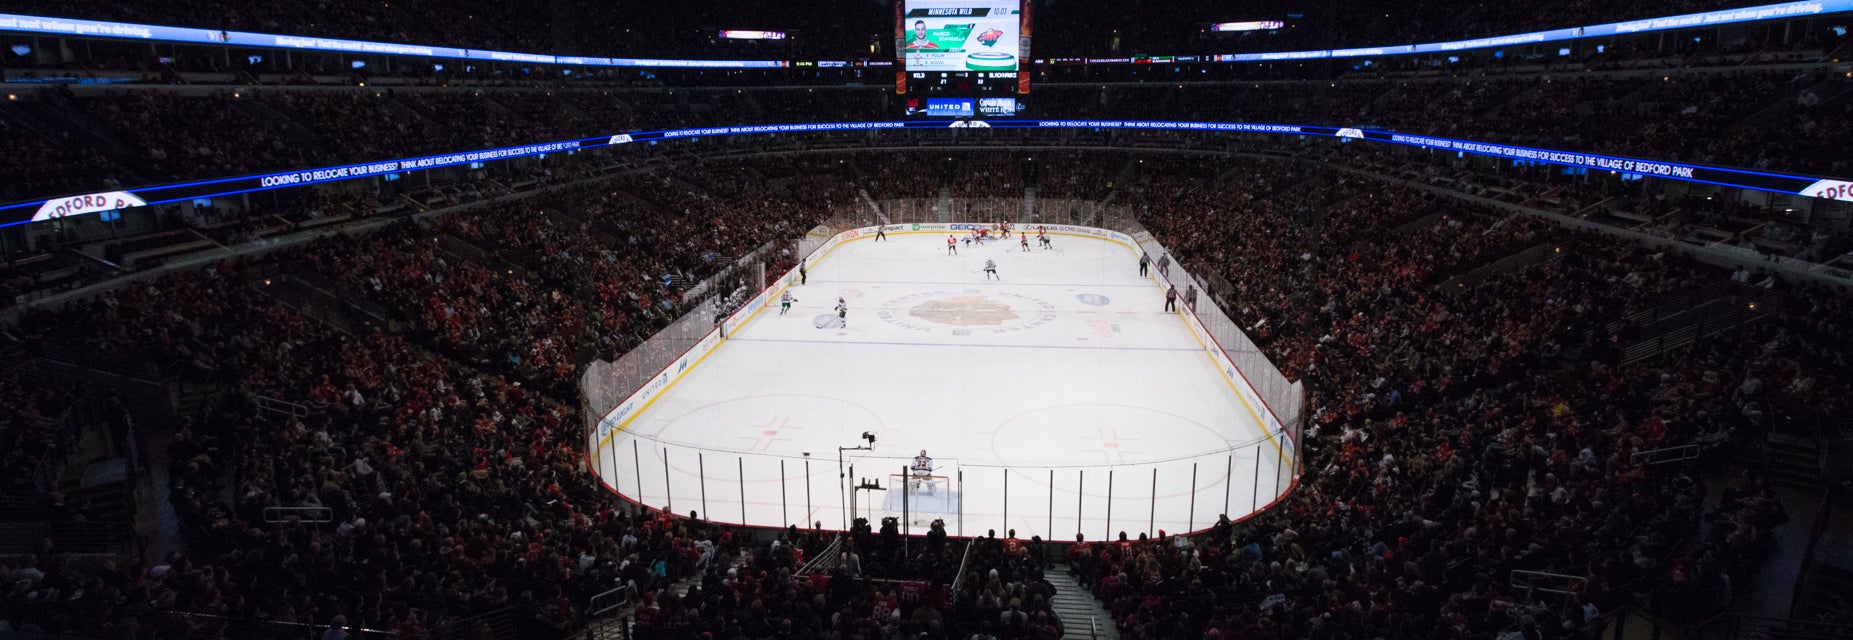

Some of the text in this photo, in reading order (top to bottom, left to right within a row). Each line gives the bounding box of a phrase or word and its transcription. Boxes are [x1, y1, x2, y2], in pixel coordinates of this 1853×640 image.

[1735, 10, 1757, 19] when
[42, 21, 75, 31] when
[261, 174, 299, 187] LOOKING
[301, 172, 312, 181] TO
[313, 168, 348, 179] RELOCATE
[349, 166, 367, 175] YOUR
[368, 163, 398, 173] BUSINESS?
[418, 158, 434, 166] ABOUT
[435, 155, 466, 164] RELOCATING
[479, 151, 498, 159] BUSINESS
[1476, 145, 1502, 154] RELOCATING
[1516, 149, 1537, 158] BUSINESS
[1550, 153, 1574, 162] SUCCESS
[1576, 156, 1584, 164] TO
[1585, 157, 1595, 165] THE
[1597, 158, 1623, 169] VILLAGE
[1624, 161, 1634, 170] OF
[1636, 162, 1671, 175] BEDFORD
[1673, 166, 1693, 177] PARK
[642, 379, 662, 399] UNITED
